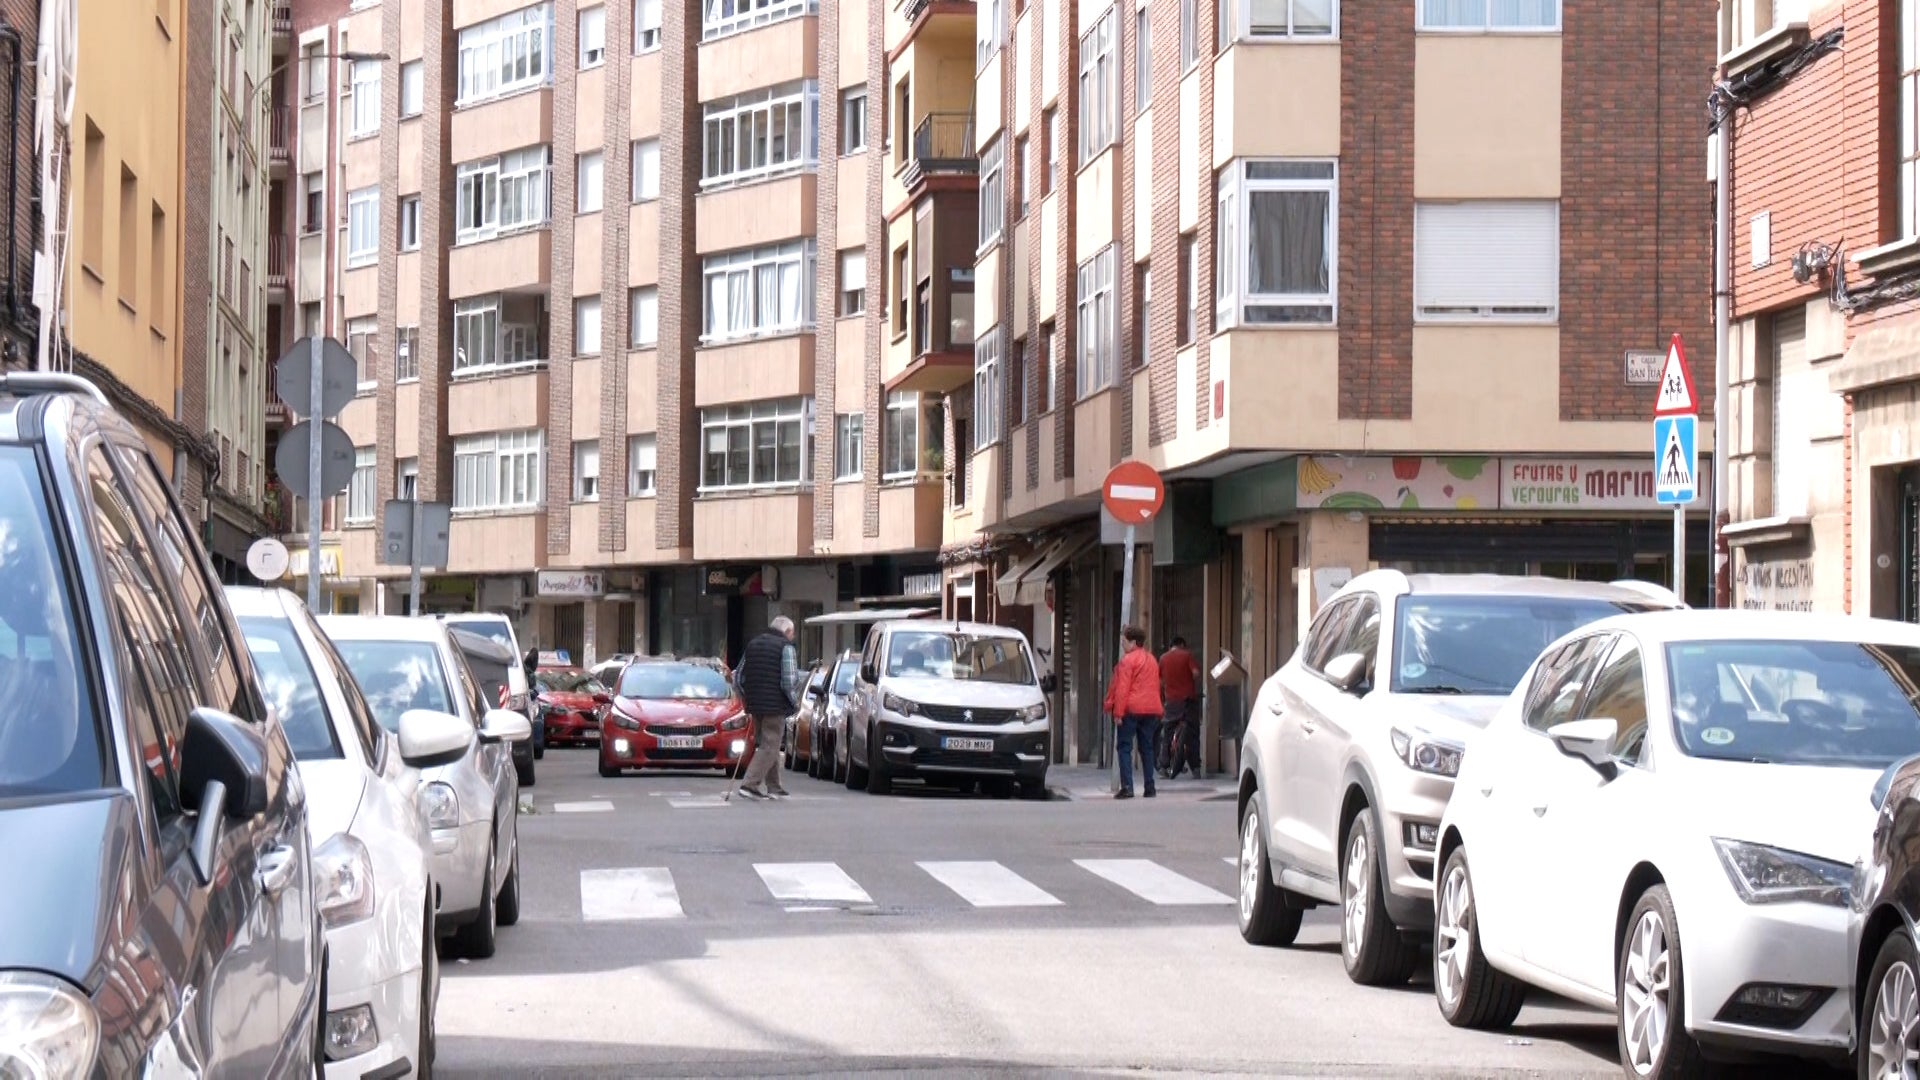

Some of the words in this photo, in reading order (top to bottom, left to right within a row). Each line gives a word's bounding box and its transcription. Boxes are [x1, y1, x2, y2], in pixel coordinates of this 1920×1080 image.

[1630, 368, 1645, 379] SAN
[1514, 464, 1563, 482] FRUTAS
[1512, 485, 1579, 504] VERDURAS
